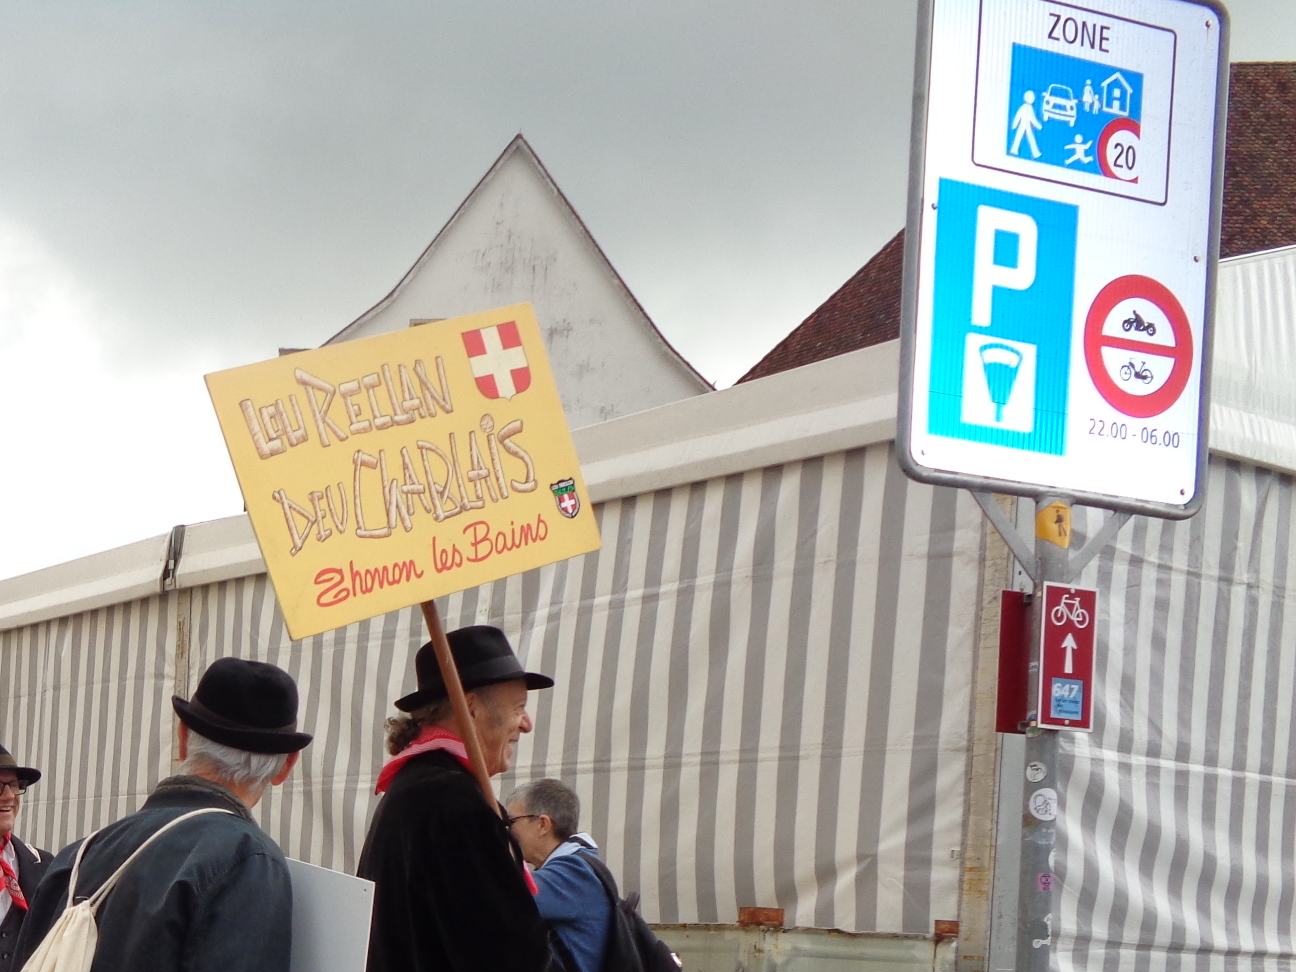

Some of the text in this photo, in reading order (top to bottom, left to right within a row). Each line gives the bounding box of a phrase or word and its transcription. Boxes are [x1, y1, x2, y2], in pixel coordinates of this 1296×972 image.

[1047, 12, 1111, 54] ZONE
[1113, 141, 1137, 171] 20
[970, 203, 1039, 328] P
[238, 393, 309, 461] LOU
[1088, 417, 1128, 440] 22.00
[1140, 426, 1181, 448] 06.00
[271, 481, 349, 557] DEU
[431, 536, 464, 574] les
[462, 512, 549, 563] Bains
[1053, 682, 1080, 698] 647
